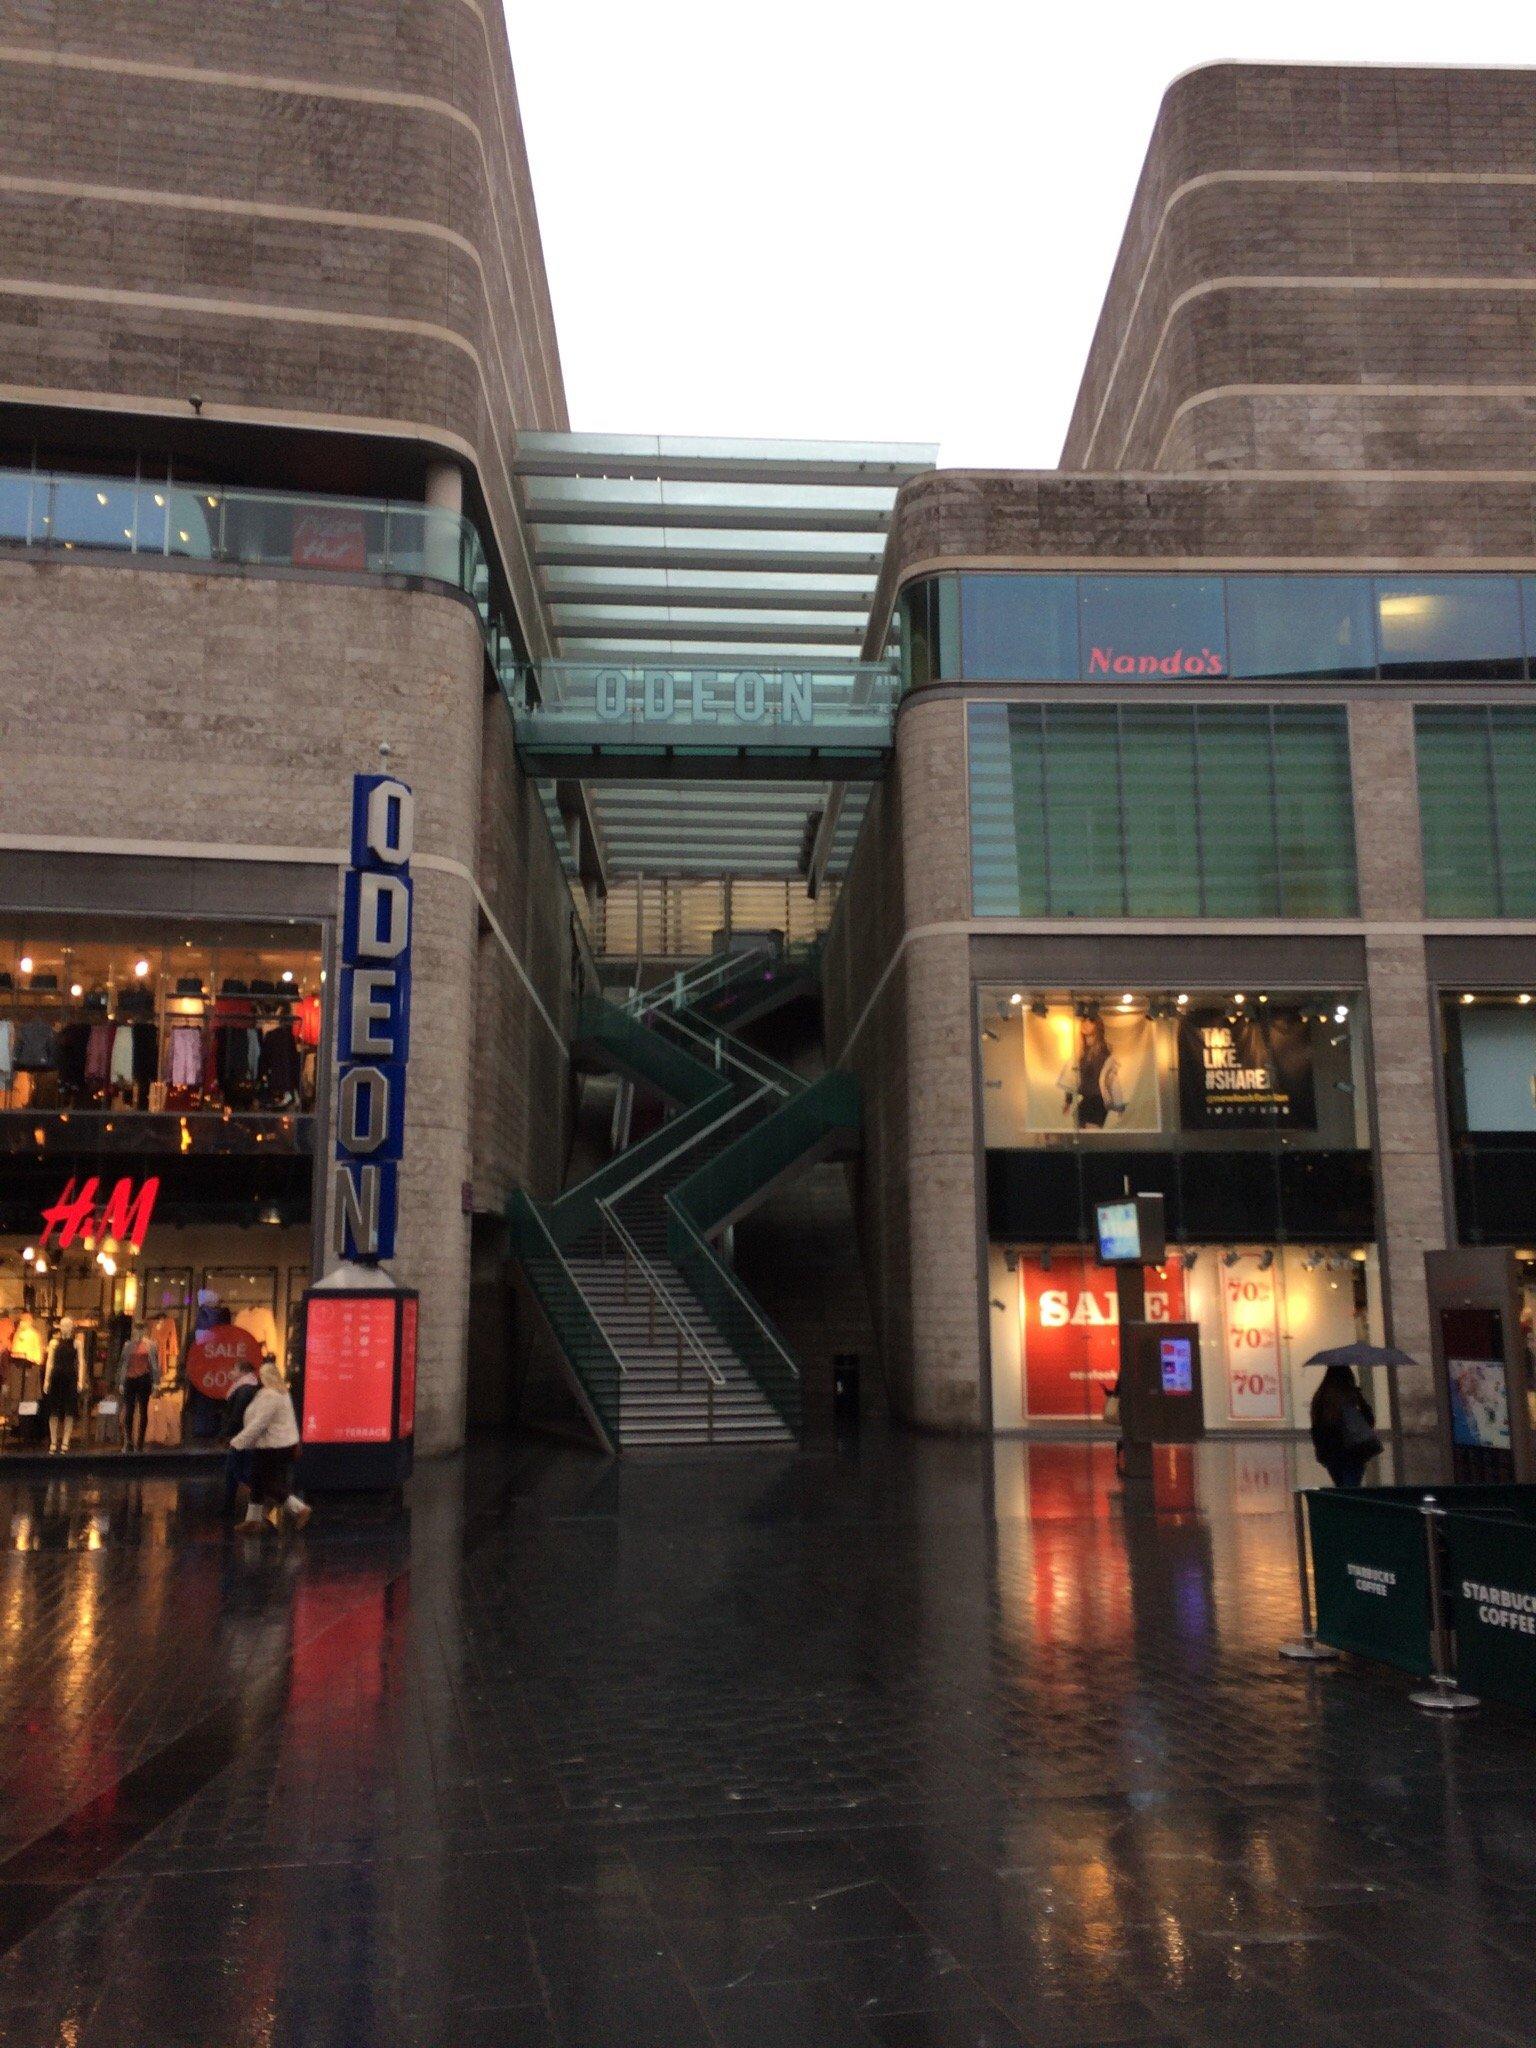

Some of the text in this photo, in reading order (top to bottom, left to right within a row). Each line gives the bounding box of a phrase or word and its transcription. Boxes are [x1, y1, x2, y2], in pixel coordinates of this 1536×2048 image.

[1088, 646, 1223, 676] Nando's
[595, 669, 814, 723] ODEON
[333, 779, 415, 1254] ODEON
[39, 1175, 160, 1250] H&M
[204, 1342, 247, 1359] SALE
[1479, 1605, 1536, 1635] COFFEE
